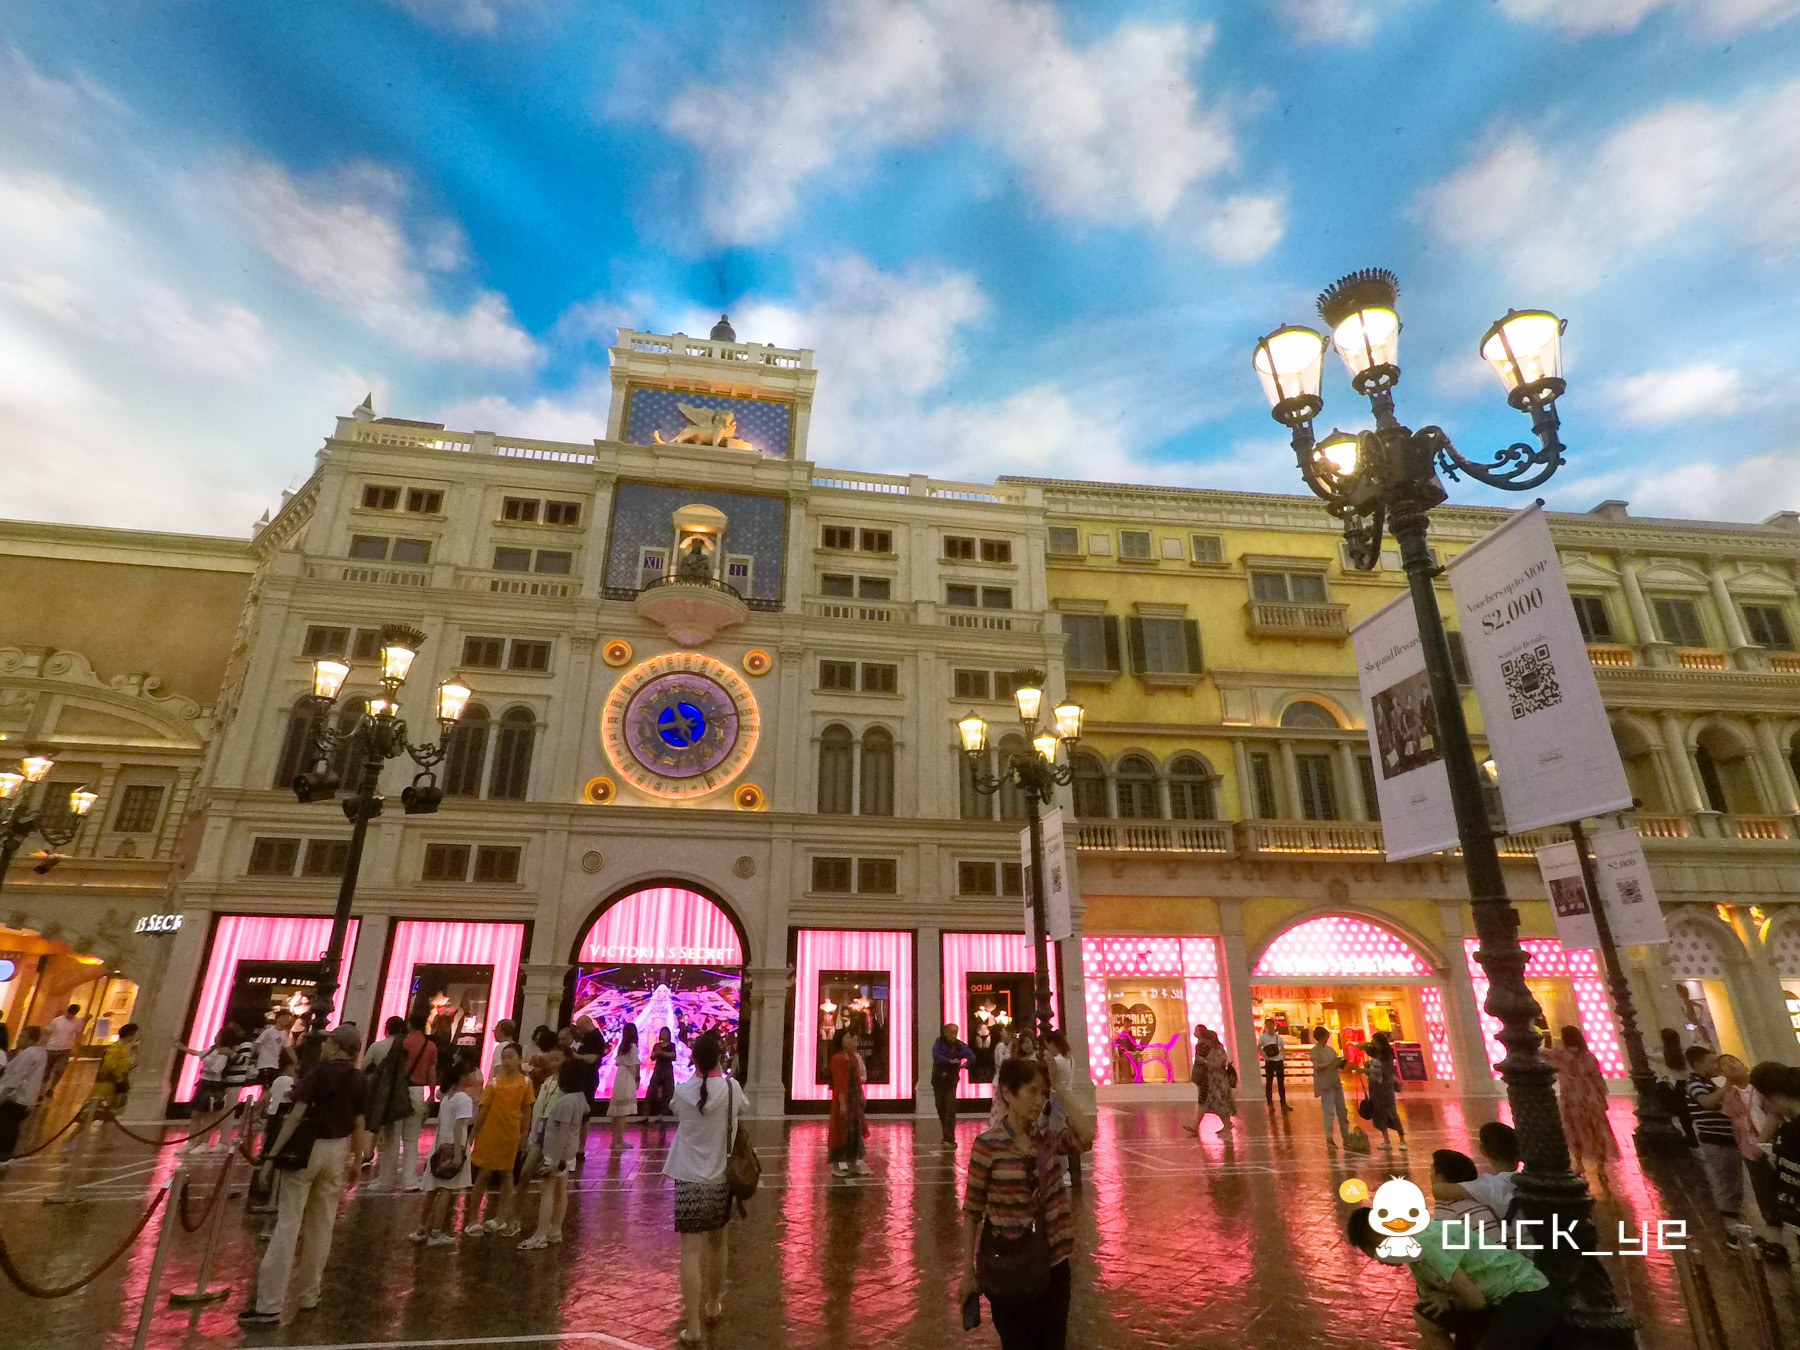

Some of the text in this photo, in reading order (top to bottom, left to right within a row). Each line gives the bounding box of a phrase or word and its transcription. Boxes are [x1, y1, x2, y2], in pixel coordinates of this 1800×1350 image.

[646, 557, 662, 569] XII
[1466, 591, 1503, 612] Vouchers
[1524, 559, 1548, 580] MOP
[1482, 587, 1543, 636] $2,000
[1381, 649, 1394, 666] and
[590, 944, 734, 960] VICTORIA'S SECRET
